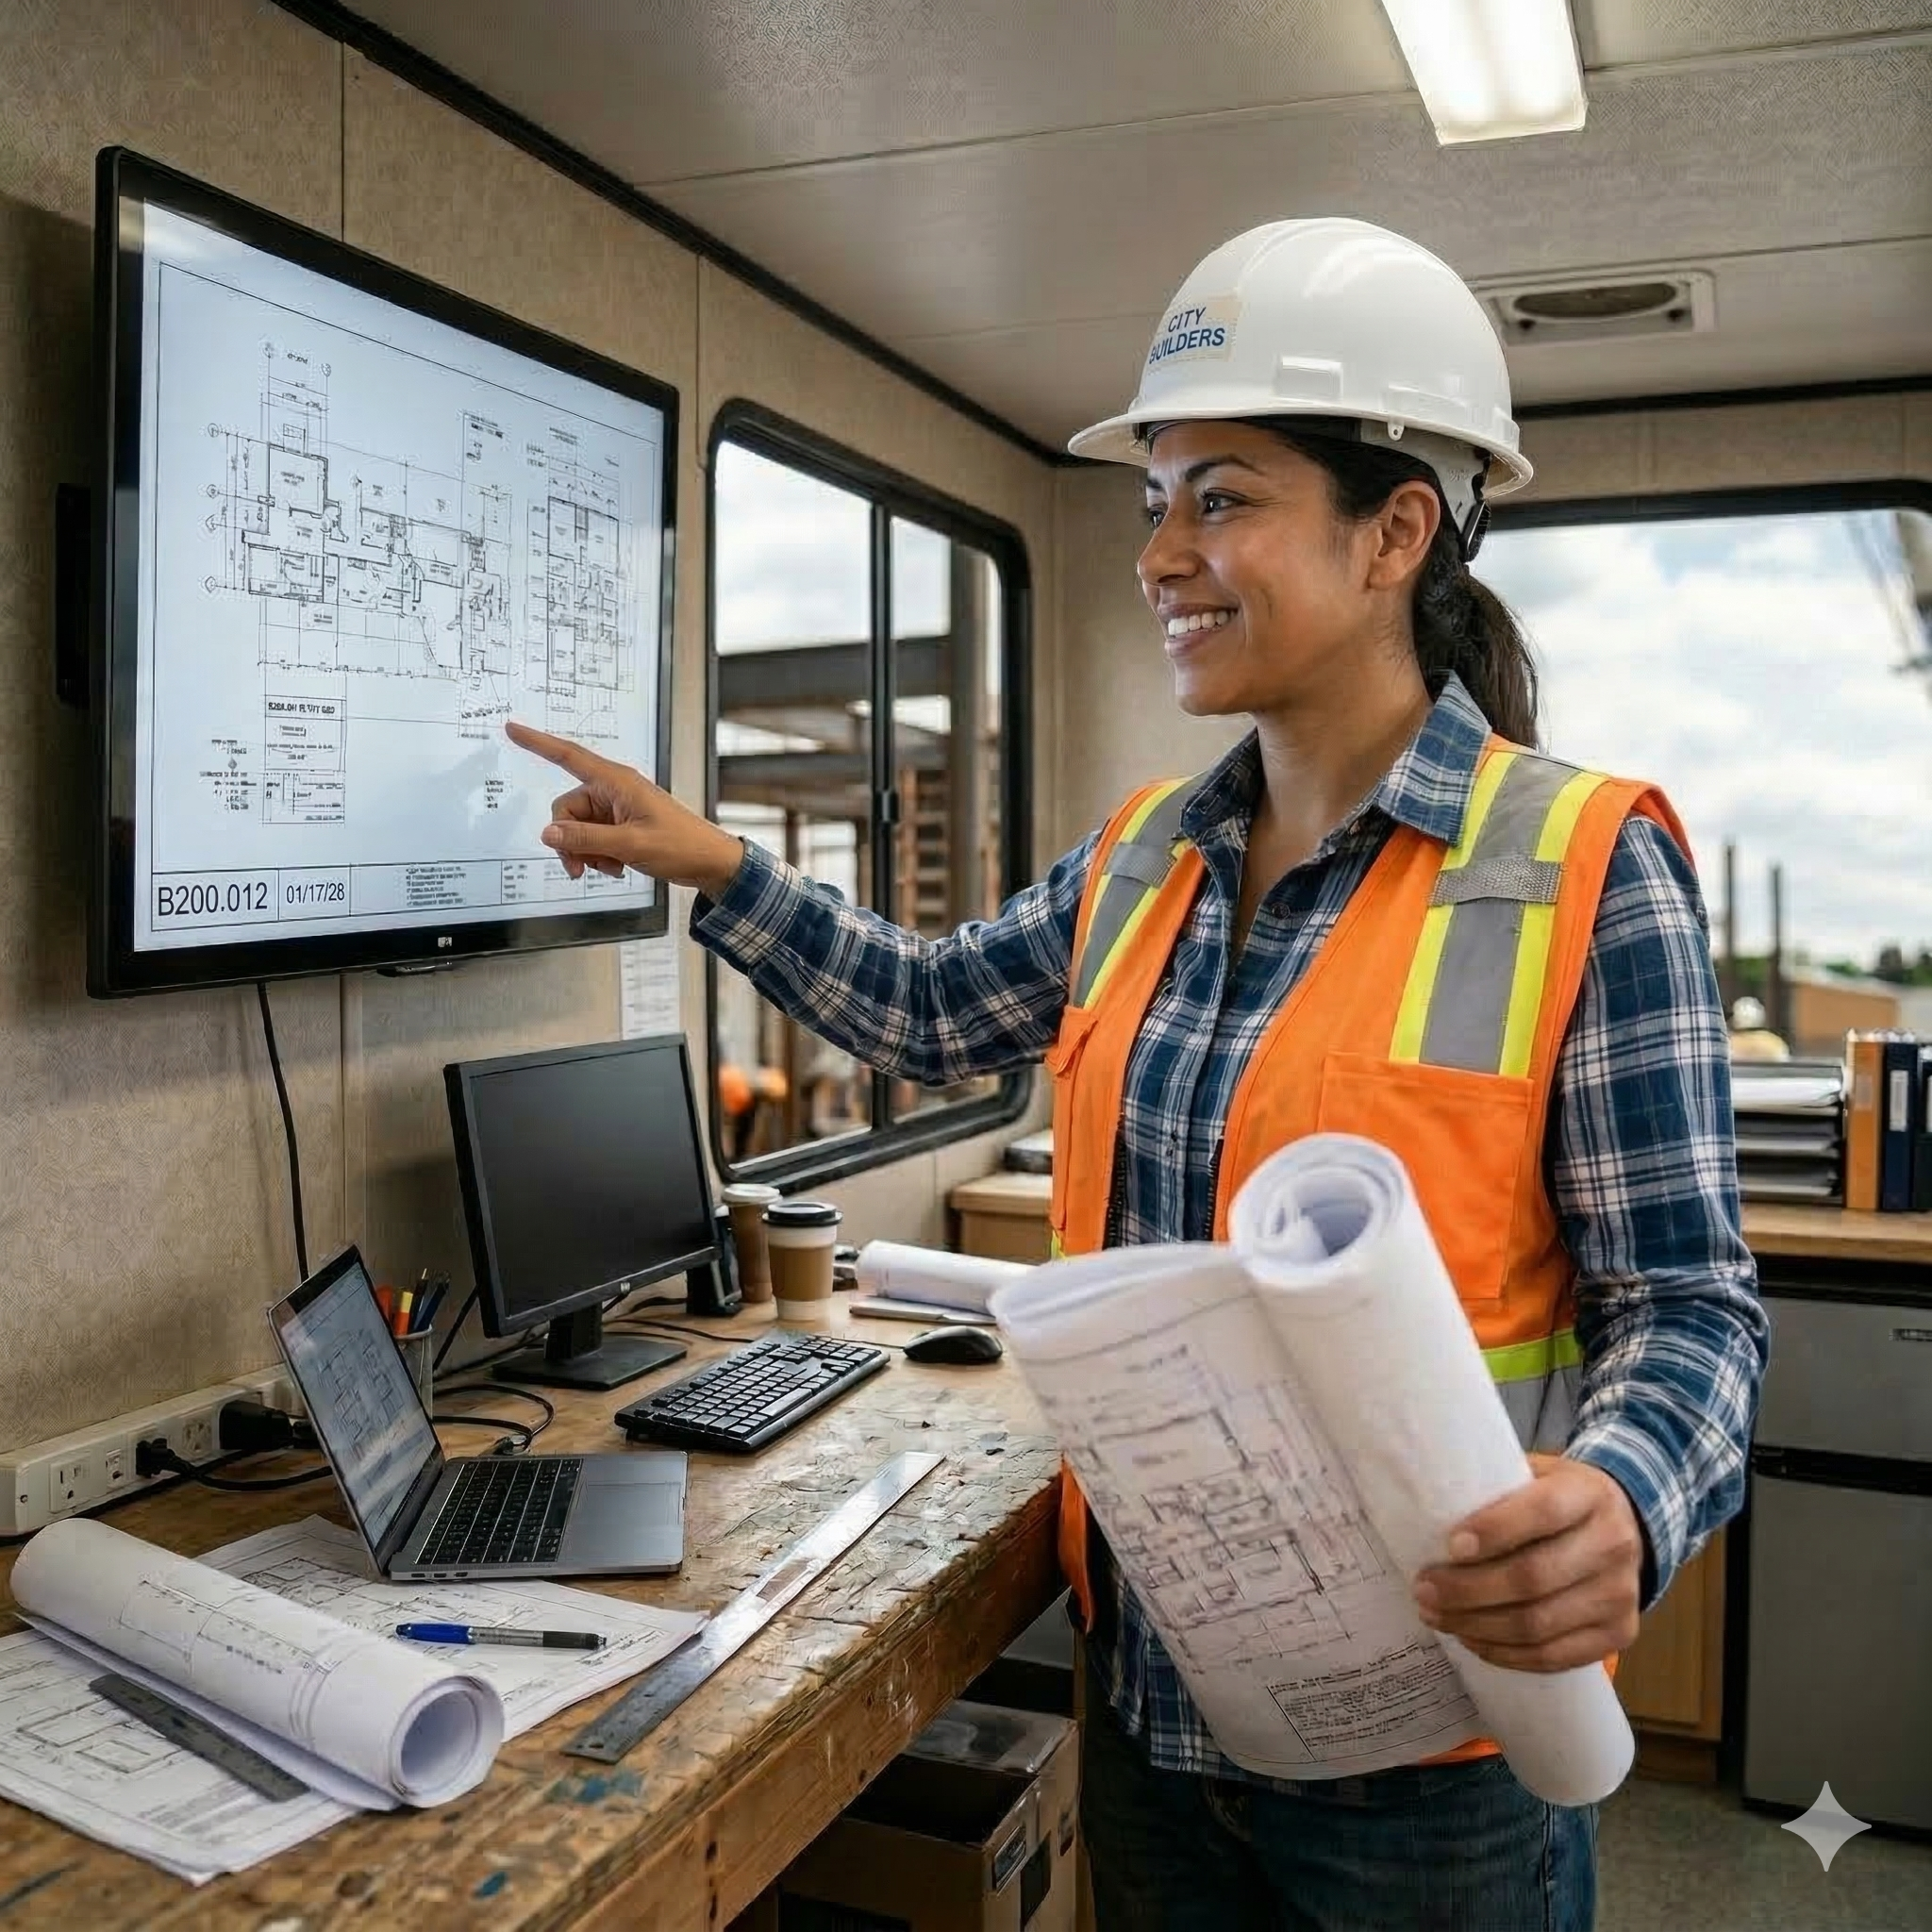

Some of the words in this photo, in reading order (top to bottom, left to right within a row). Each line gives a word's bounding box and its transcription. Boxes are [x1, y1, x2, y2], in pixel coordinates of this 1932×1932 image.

[1168, 307, 1207, 332] CITY
[1149, 327, 1225, 364] BUILDERS
[158, 882, 268, 916] B200.012
[287, 882, 345, 904] 01/17/28
